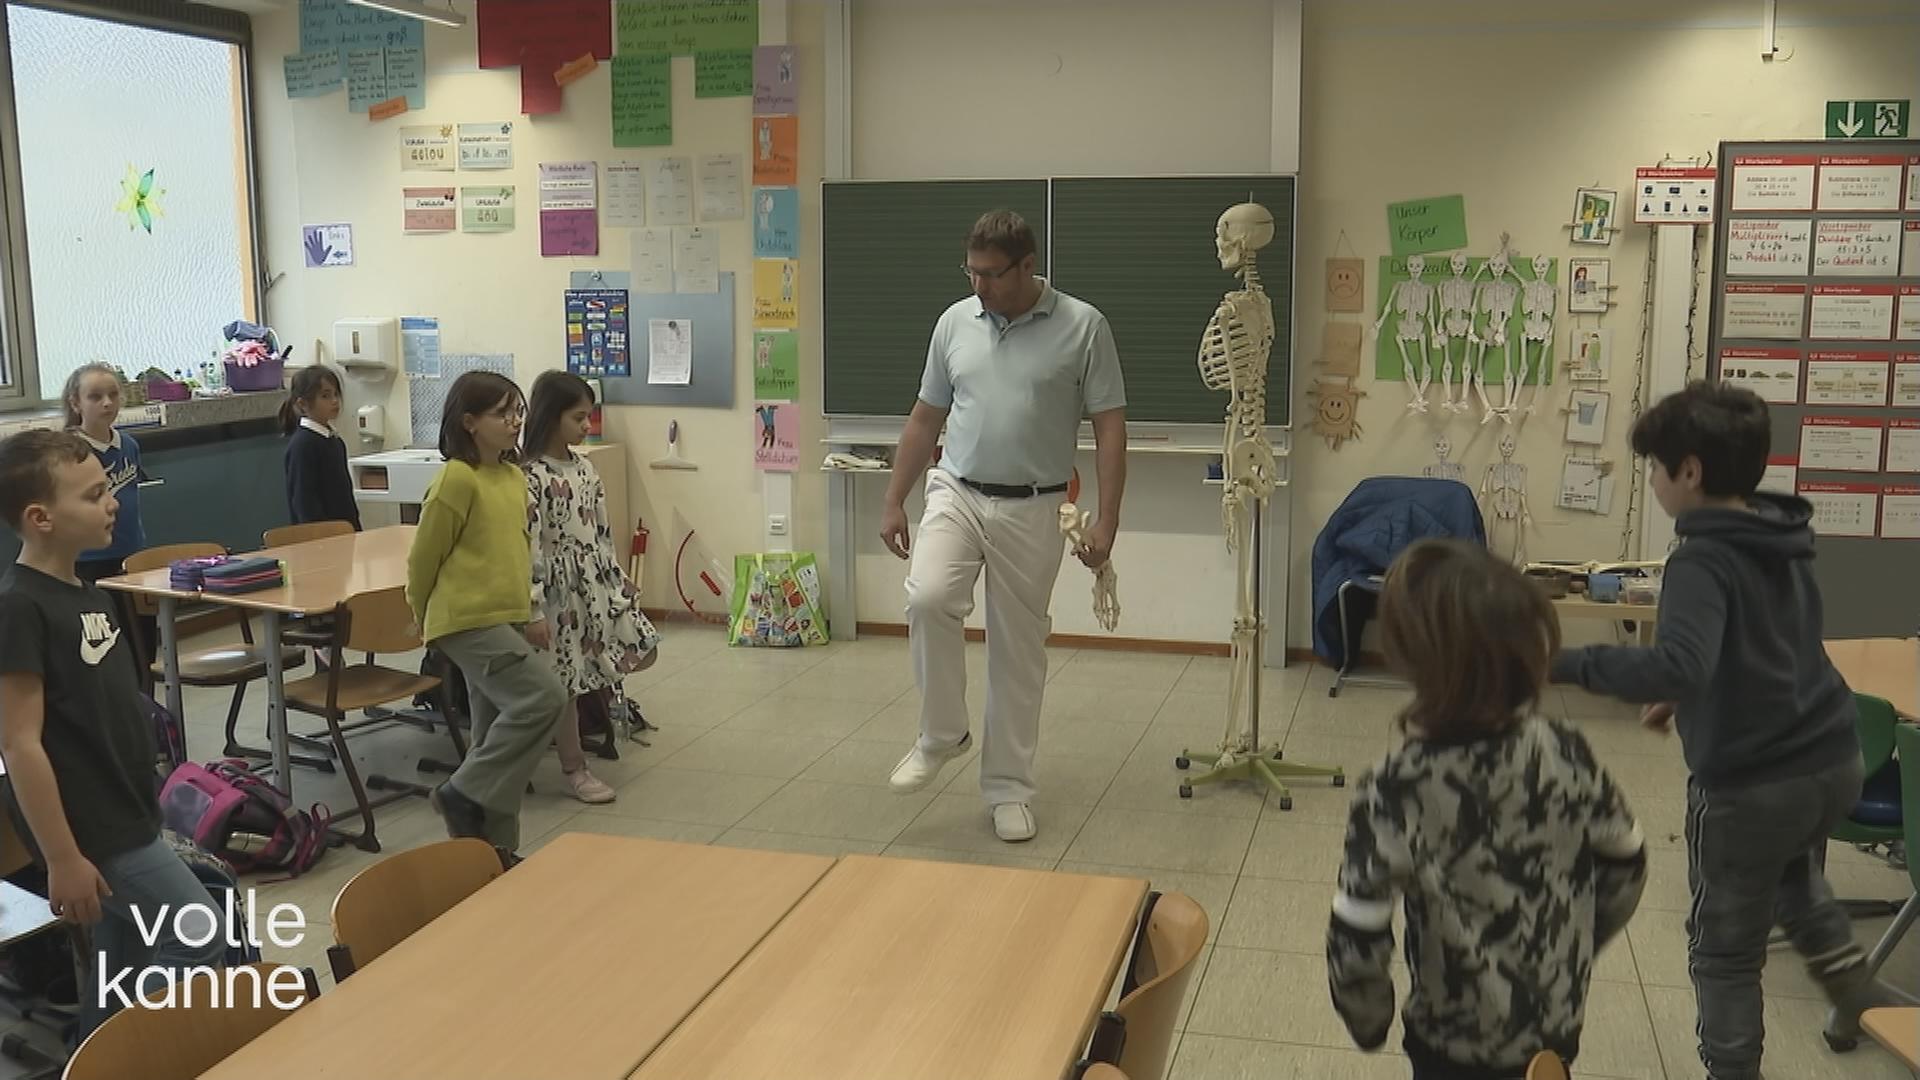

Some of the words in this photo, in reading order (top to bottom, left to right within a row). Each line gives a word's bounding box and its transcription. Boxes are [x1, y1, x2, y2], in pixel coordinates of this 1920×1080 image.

[1395, 204, 1431, 219] Unser
[1398, 224, 1439, 245] Körper
[1745, 251, 1777, 262] Produkt
[80, 613, 112, 641] NIKE
